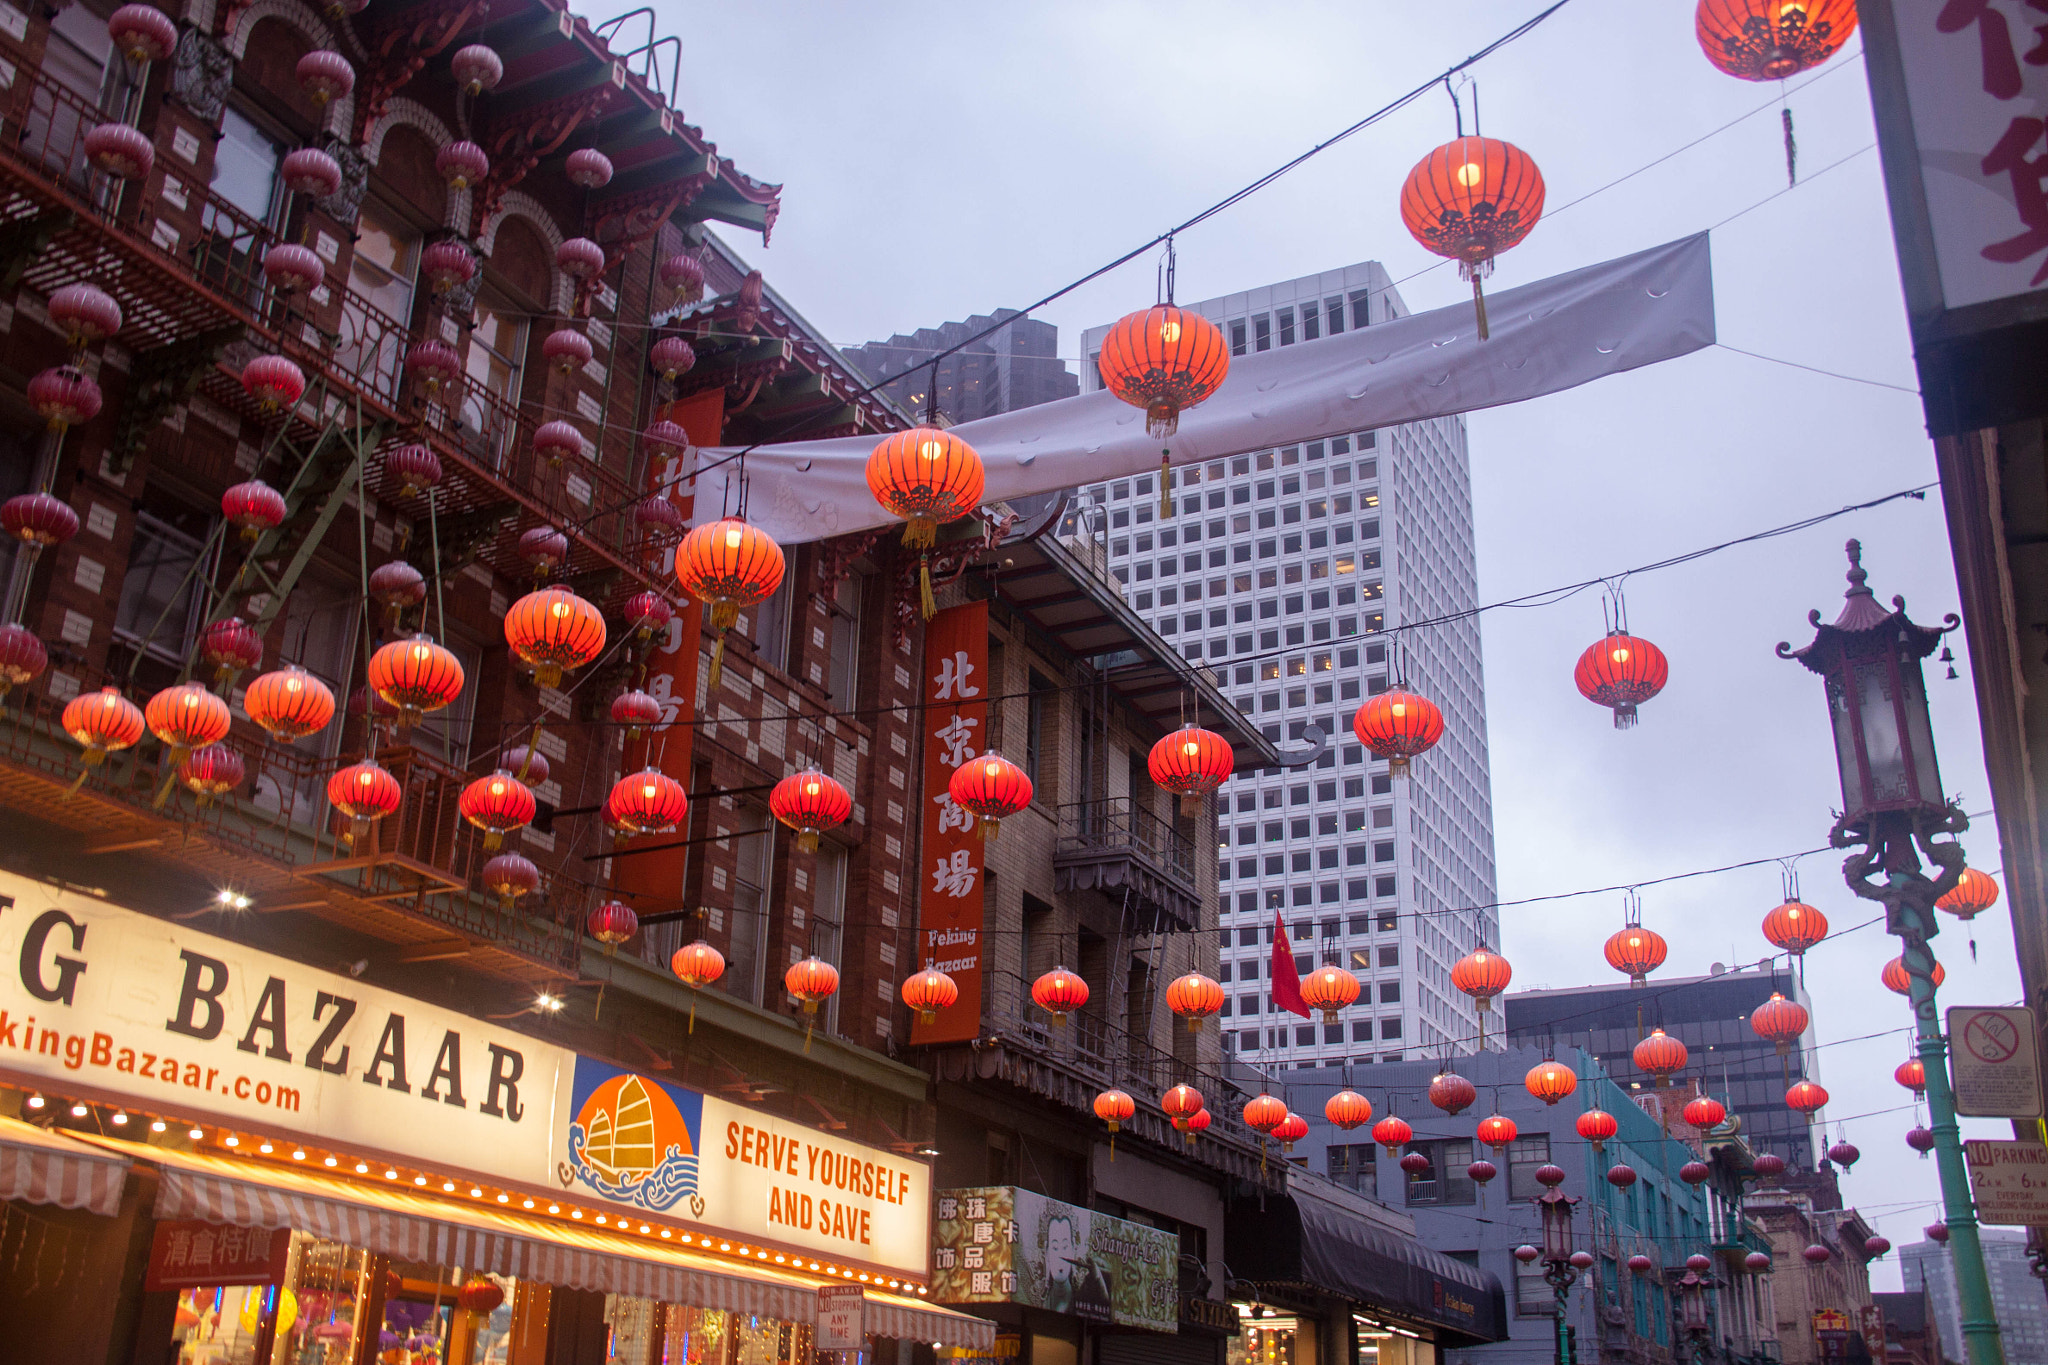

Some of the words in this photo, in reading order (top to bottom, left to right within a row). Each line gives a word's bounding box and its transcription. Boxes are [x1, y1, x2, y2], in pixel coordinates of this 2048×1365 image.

[928, 927, 977, 946] Peking
[0, 893, 88, 1007] G
[165, 947, 525, 1123] BAZAAR
[725, 1120, 799, 1176] SERVE
[807, 1144, 909, 1205] YOURSELF
[1967, 1142, 1990, 1164] NO
[1993, 1147, 2047, 1165] PARKING
[1996, 1191, 2034, 1200] EVERYDAY
[769, 1186, 813, 1231] AND
[819, 1198, 871, 1245] SAVE
[1984, 1213, 2012, 1222] STREET
[973, 1220, 1019, 1244] 唐卡
[1091, 1226, 1159, 1265] Shangri-La
[819, 1297, 830, 1312] NO
[831, 1299, 861, 1311] STOPPING
[1151, 1278, 1179, 1308] Gifts
[830, 1314, 849, 1326] ANY
[829, 1327, 850, 1339] TIME
